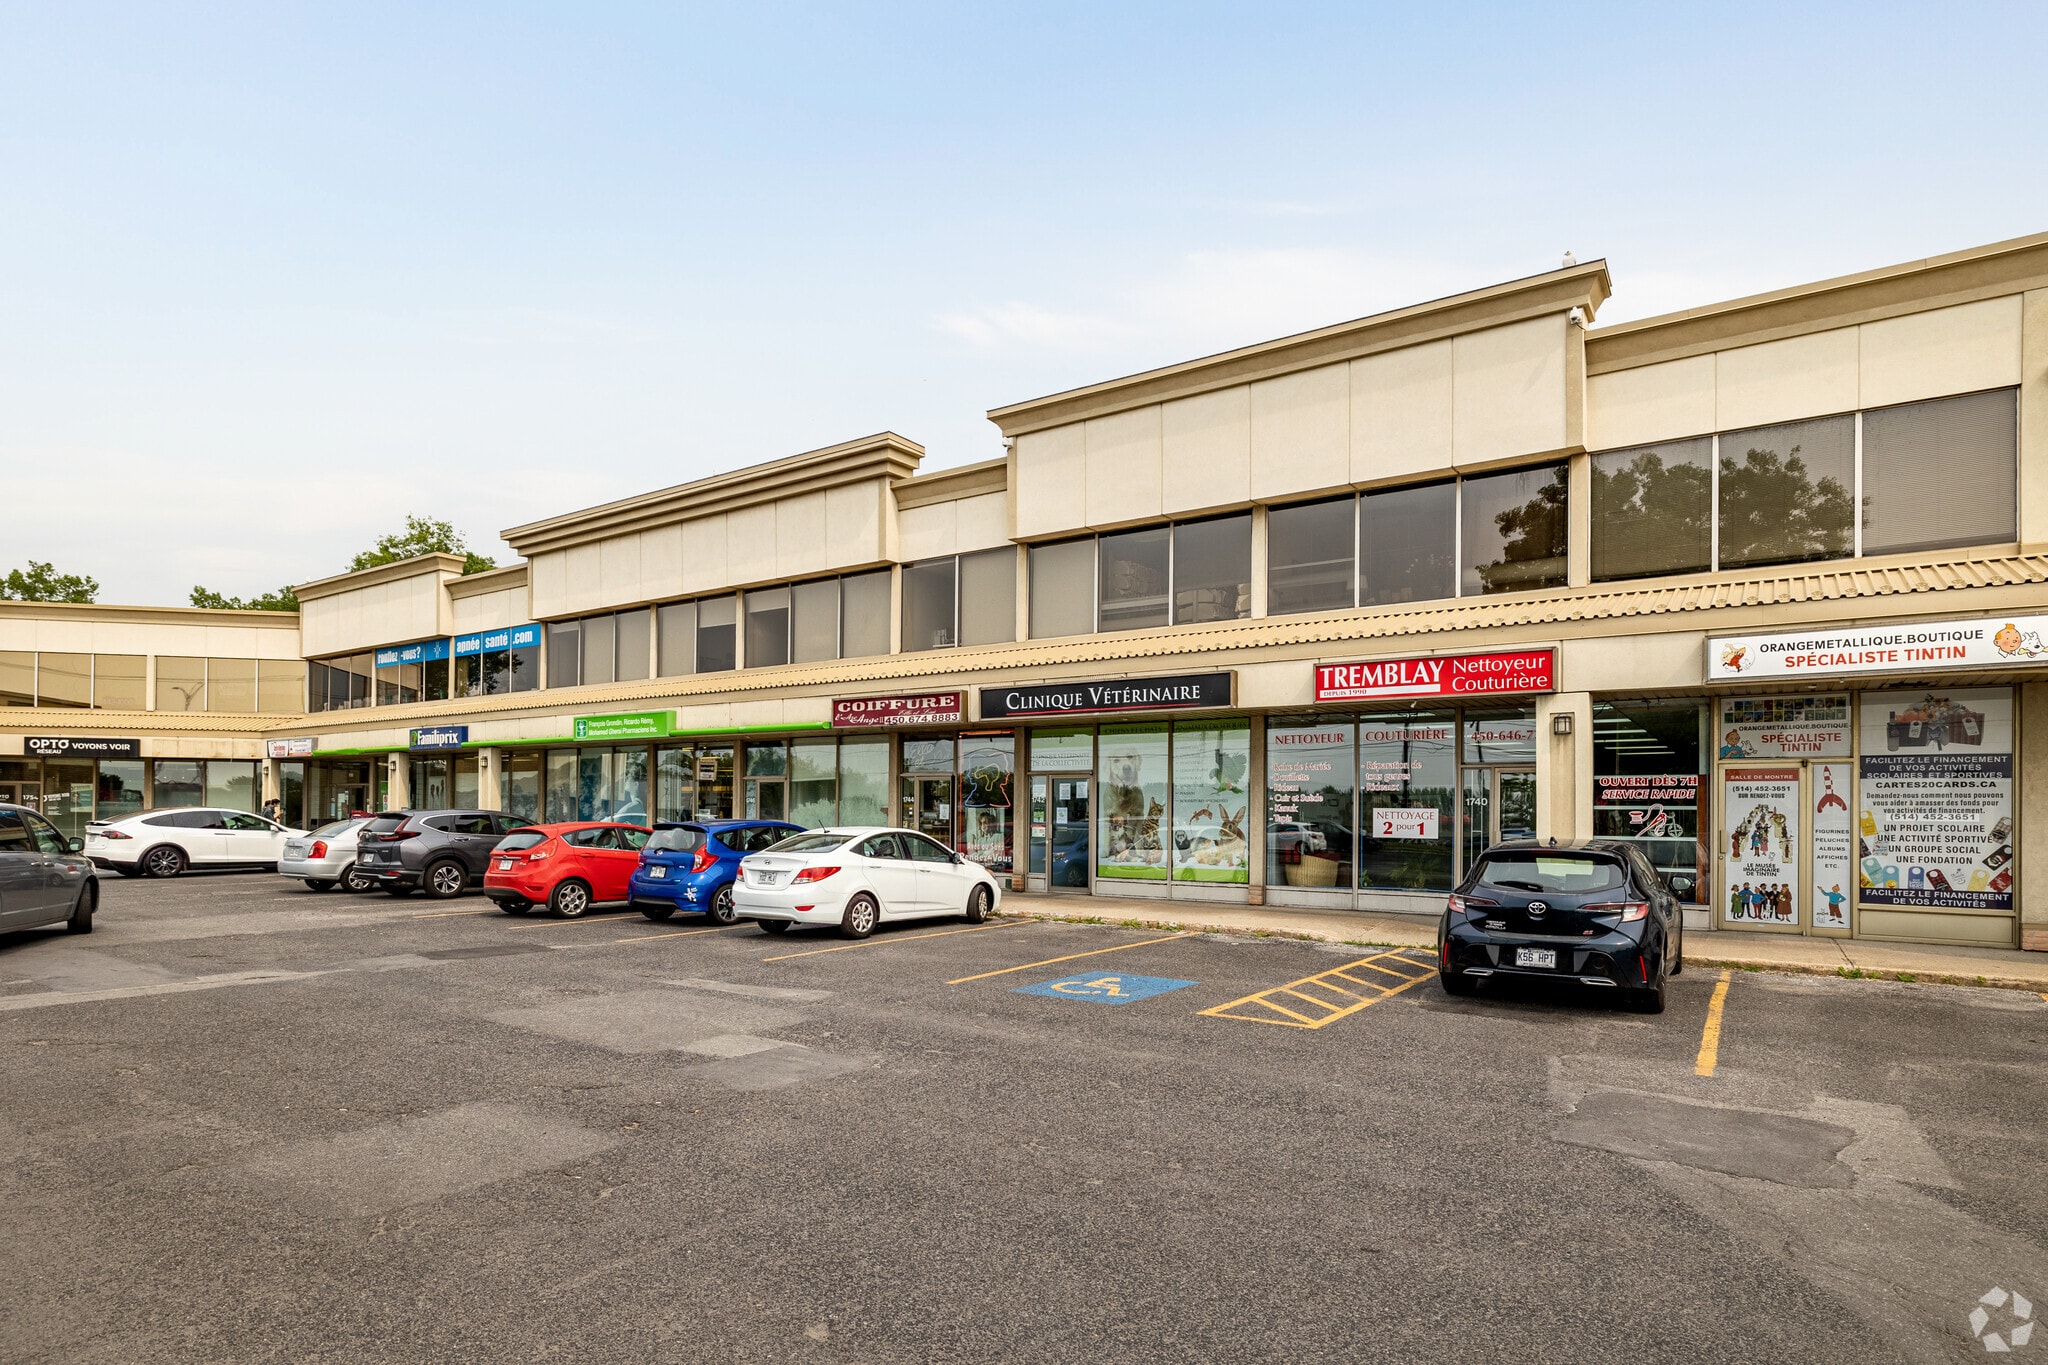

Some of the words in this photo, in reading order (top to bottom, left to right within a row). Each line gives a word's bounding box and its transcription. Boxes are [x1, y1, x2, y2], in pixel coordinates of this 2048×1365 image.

[456, 638, 480, 653] apnée
[485, 632, 508, 649] santé
[512, 631, 532, 644] .com
[1760, 629, 1984, 653] ORANGEMETALLIQUE.BOUTIQUE
[1785, 650, 1898, 668] SPÉCIALISTE
[1904, 645, 1966, 662] TINTIN
[1320, 660, 1444, 688] TREMBLAY
[1453, 657, 1546, 675] Nettoyeur
[1452, 672, 1548, 692] Couturière
[1088, 685, 1200, 704] VÉTÉRINAIRE
[838, 696, 954, 712] COIFFURE
[885, 714, 958, 724] 450.674.8883
[1739, 722, 1848, 732] ORANGEMETALLIQUE.BOUTIQUE
[418, 730, 458, 746] Familiprix
[1276, 733, 1344, 744] NETTOYEUR
[1366, 727, 1448, 742] COUTURIÈRE
[1472, 730, 1536, 741] 450-646-7
[1762, 732, 1842, 743] SPÉCIALISTE
[30, 739, 69, 748] OPTO
[1780, 743, 1822, 752] TINTIN
[1600, 776, 1649, 786] OUVERT
[1652, 774, 1678, 786] DÈS
[1680, 776, 1698, 786] 7H
[1602, 789, 1650, 799] SERVICE
[1650, 788, 1696, 799] RAPIDE
[1466, 798, 1488, 806] 1740
[1377, 811, 1434, 820] NETTOYAGE
[1384, 822, 1392, 834] 2
[1417, 822, 1424, 835] 1
[1938, 824, 1985, 832] SCOLAIRE
[1899, 834, 1942, 842] ACTIVITÉ
[1944, 835, 1993, 844] SPORTIVE
[1918, 856, 1972, 864] FONDATION
[1934, 891, 2009, 900] FINANCEMENT
[1932, 898, 1986, 908] ACTIVITÉS
[1518, 952, 1534, 962] K56
[1538, 954, 1554, 963] HPT
